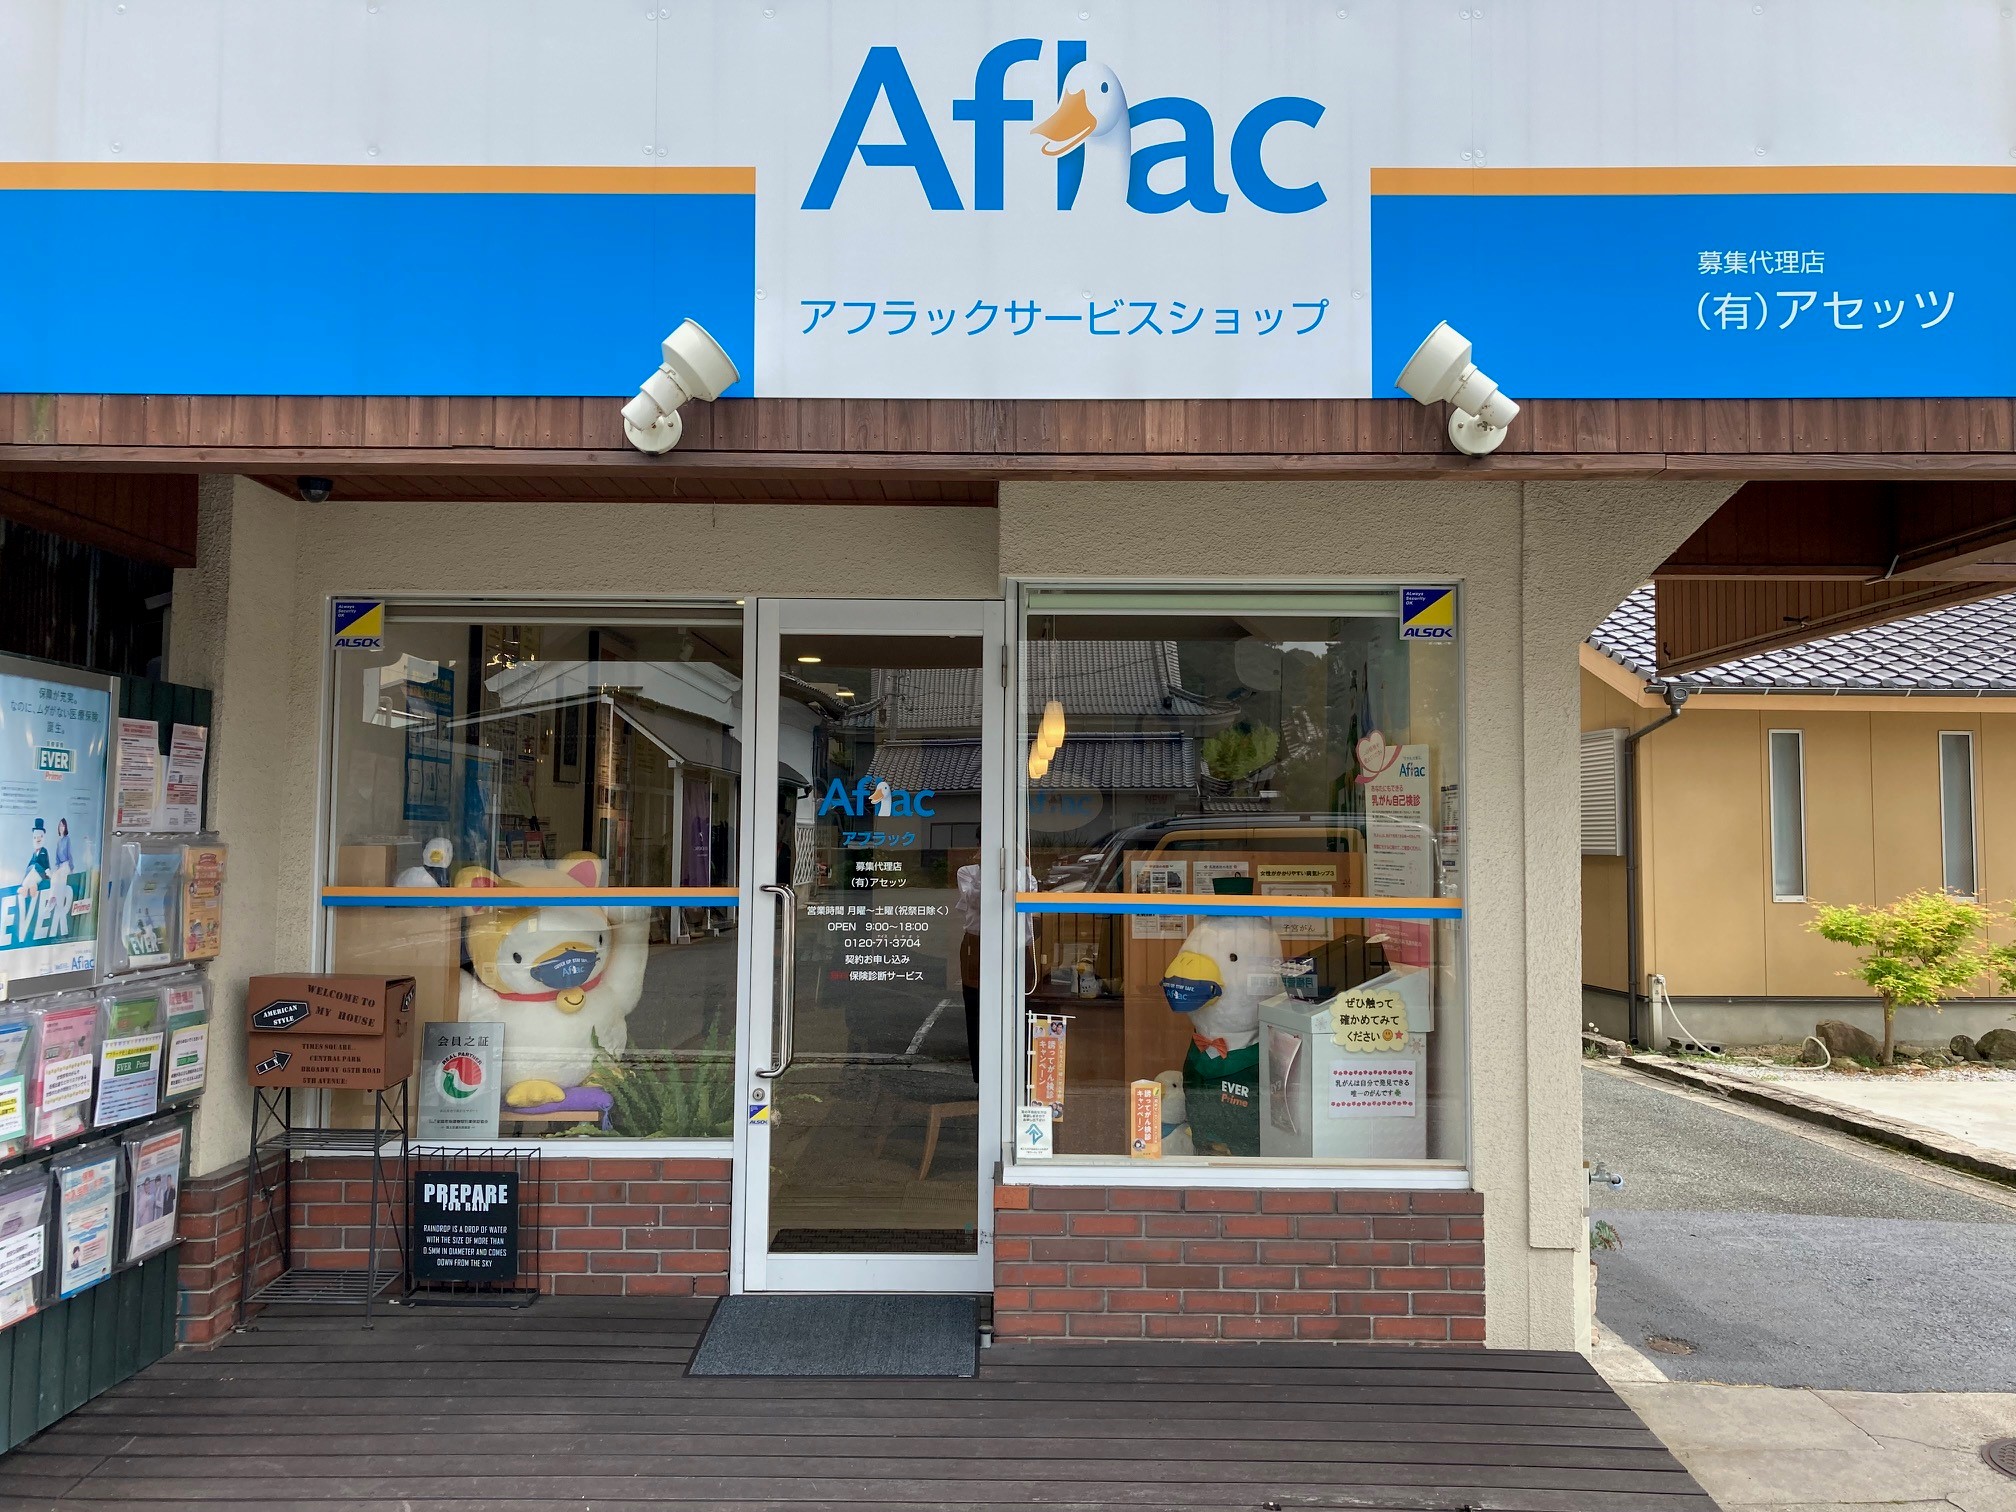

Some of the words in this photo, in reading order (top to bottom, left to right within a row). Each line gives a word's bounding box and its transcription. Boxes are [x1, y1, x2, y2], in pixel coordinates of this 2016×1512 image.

[800, 38, 1328, 214] Aflac
[1698, 250, 1825, 275] 募集代理店
[1698, 291, 1955, 331] (有)アセッツ
[800, 298, 1330, 336] アフラックサービスショップ
[1403, 627, 1453, 638] ALSOK
[335, 638, 380, 648] ALSOK
[40, 750, 69, 770] EVER
[45, 771, 63, 781] Prime
[1371, 794, 1421, 807] 乳がん自己検診
[842, 831, 916, 847] アフラック
[855, 861, 903, 872] 募集代理店
[851, 877, 908, 888] (有)アセッツ
[72, 901, 91, 914] Prime
[807, 906, 845, 916] 営業時間
[0, 886, 74, 947] EVER
[827, 922, 857, 931] OPEN
[865, 922, 929, 931] 9:00～18:00
[1283, 924, 1316, 933] 子宮がん
[844, 938, 921, 948] 0120-71-3704
[845, 954, 911, 965] 契約お申し込み
[850, 970, 924, 981] 保険診断サービス
[307, 984, 359, 1004] WELCOME
[362, 996, 376, 1008] TO
[1345, 997, 1394, 1009] ぜひ触って
[263, 1004, 298, 1018] AMERICAN
[315, 1006, 332, 1017] MY
[338, 1011, 376, 1027] HOUSE
[273, 1015, 295, 1026] STYLE
[1340, 1014, 1400, 1026] 確かめてみて
[438, 1035, 489, 1047] 会員之証
[1347, 1031, 1380, 1042] ください
[442, 1053, 457, 1065] REAL
[458, 1052, 482, 1065] PARTNER
[116, 1062, 132, 1072] EVER
[1221, 1080, 1249, 1098] EVER
[1335, 1079, 1410, 1088] 乳がんは自分で発見できる
[1350, 1089, 1394, 1097] 唯一のがんです
[1221, 1093, 1249, 1107] Prime
[424, 1183, 508, 1204] PREPARE
[442, 1199, 461, 1211] FOR
[465, 1201, 489, 1212] RAIN
[423, 1224, 451, 1233] RAINDROP
[464, 1225, 480, 1234] DROP
[481, 1226, 487, 1234] OF
[489, 1226, 508, 1234] WATER
[426, 1236, 440, 1244] WITH
[441, 1236, 451, 1244] THE
[474, 1237, 488, 1245] MORE
[423, 1247, 441, 1255] 0.5MM
[442, 1247, 448, 1255] IN
[449, 1247, 475, 1256] DIAMETER
[476, 1248, 487, 1256] AND
[488, 1249, 507, 1257] COMES
[436, 1258, 453, 1266] DOWN
[454, 1259, 469, 1267] FROM
[470, 1259, 480, 1267] THE
